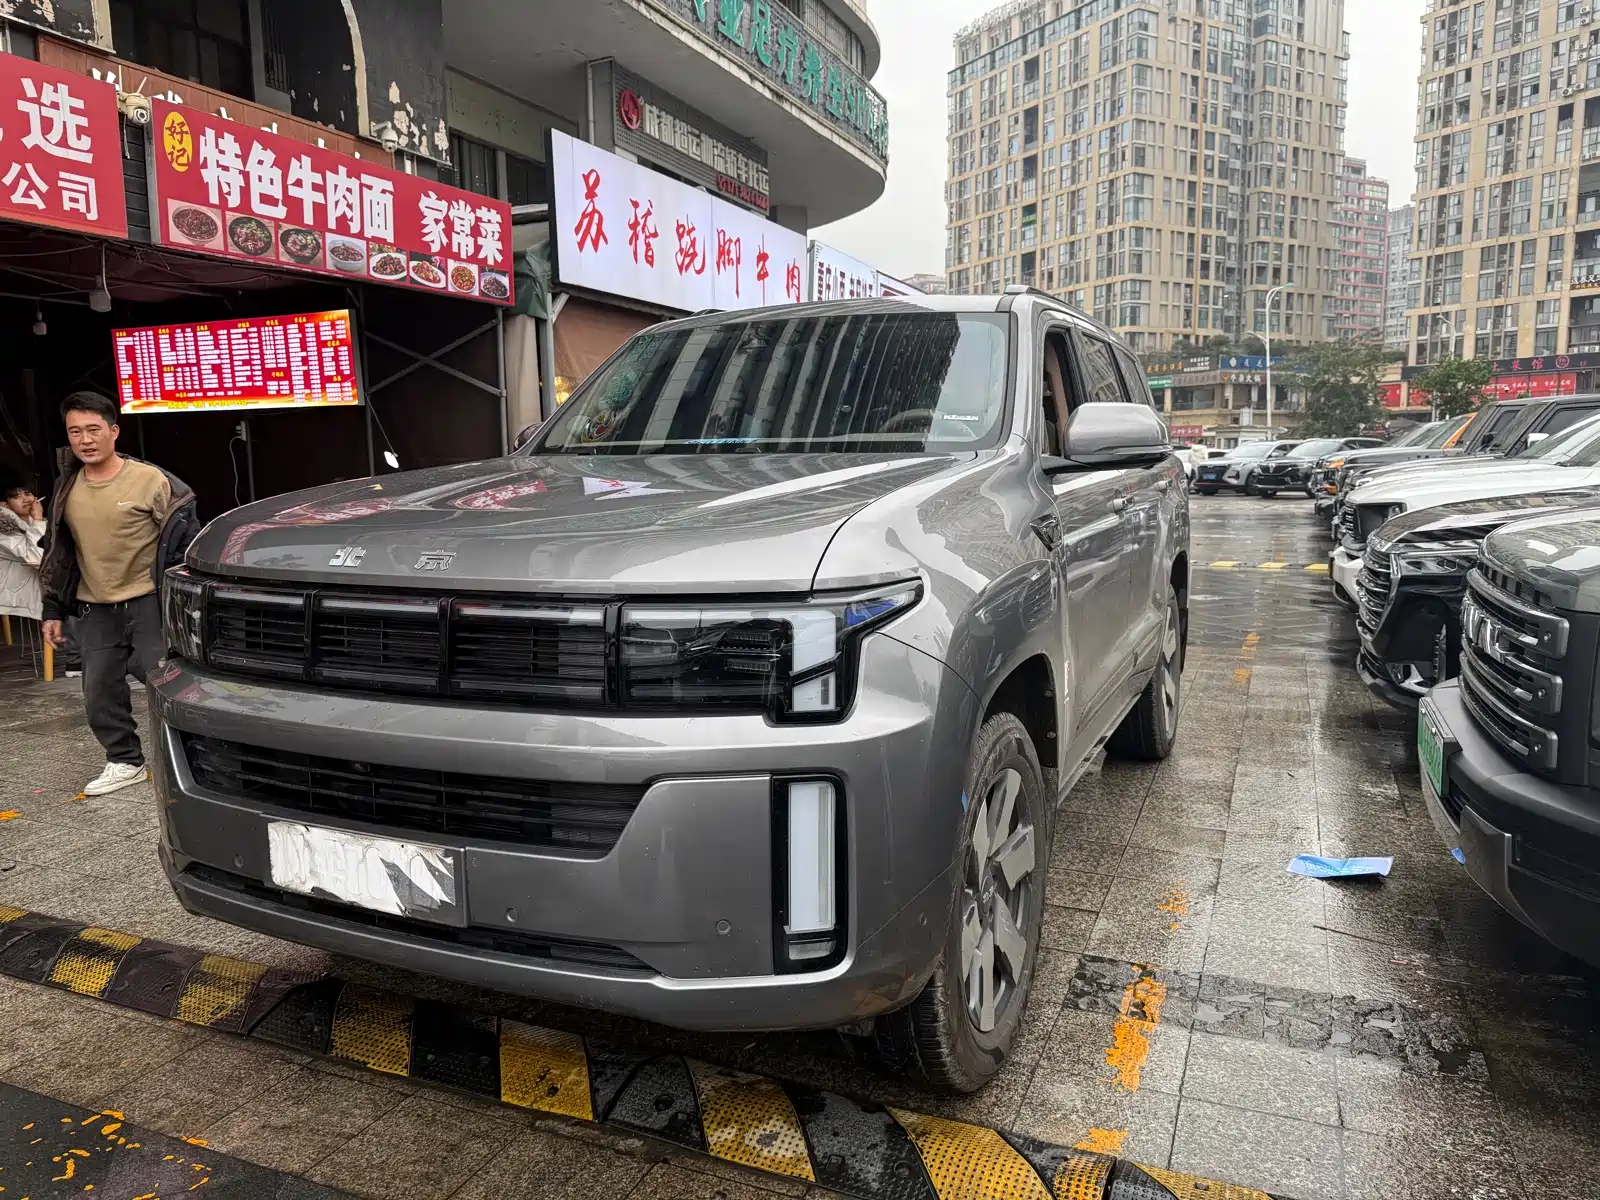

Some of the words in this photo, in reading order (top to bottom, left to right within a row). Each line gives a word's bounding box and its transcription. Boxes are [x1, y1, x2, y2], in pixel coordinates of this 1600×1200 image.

[0, 78, 93, 164] 选
[165, 119, 190, 168] 好记
[1, 161, 99, 221] 公司
[200, 126, 395, 243] 特色牛肉面
[418, 190, 503, 265] 家常菜
[328, 546, 458, 571] 北京
